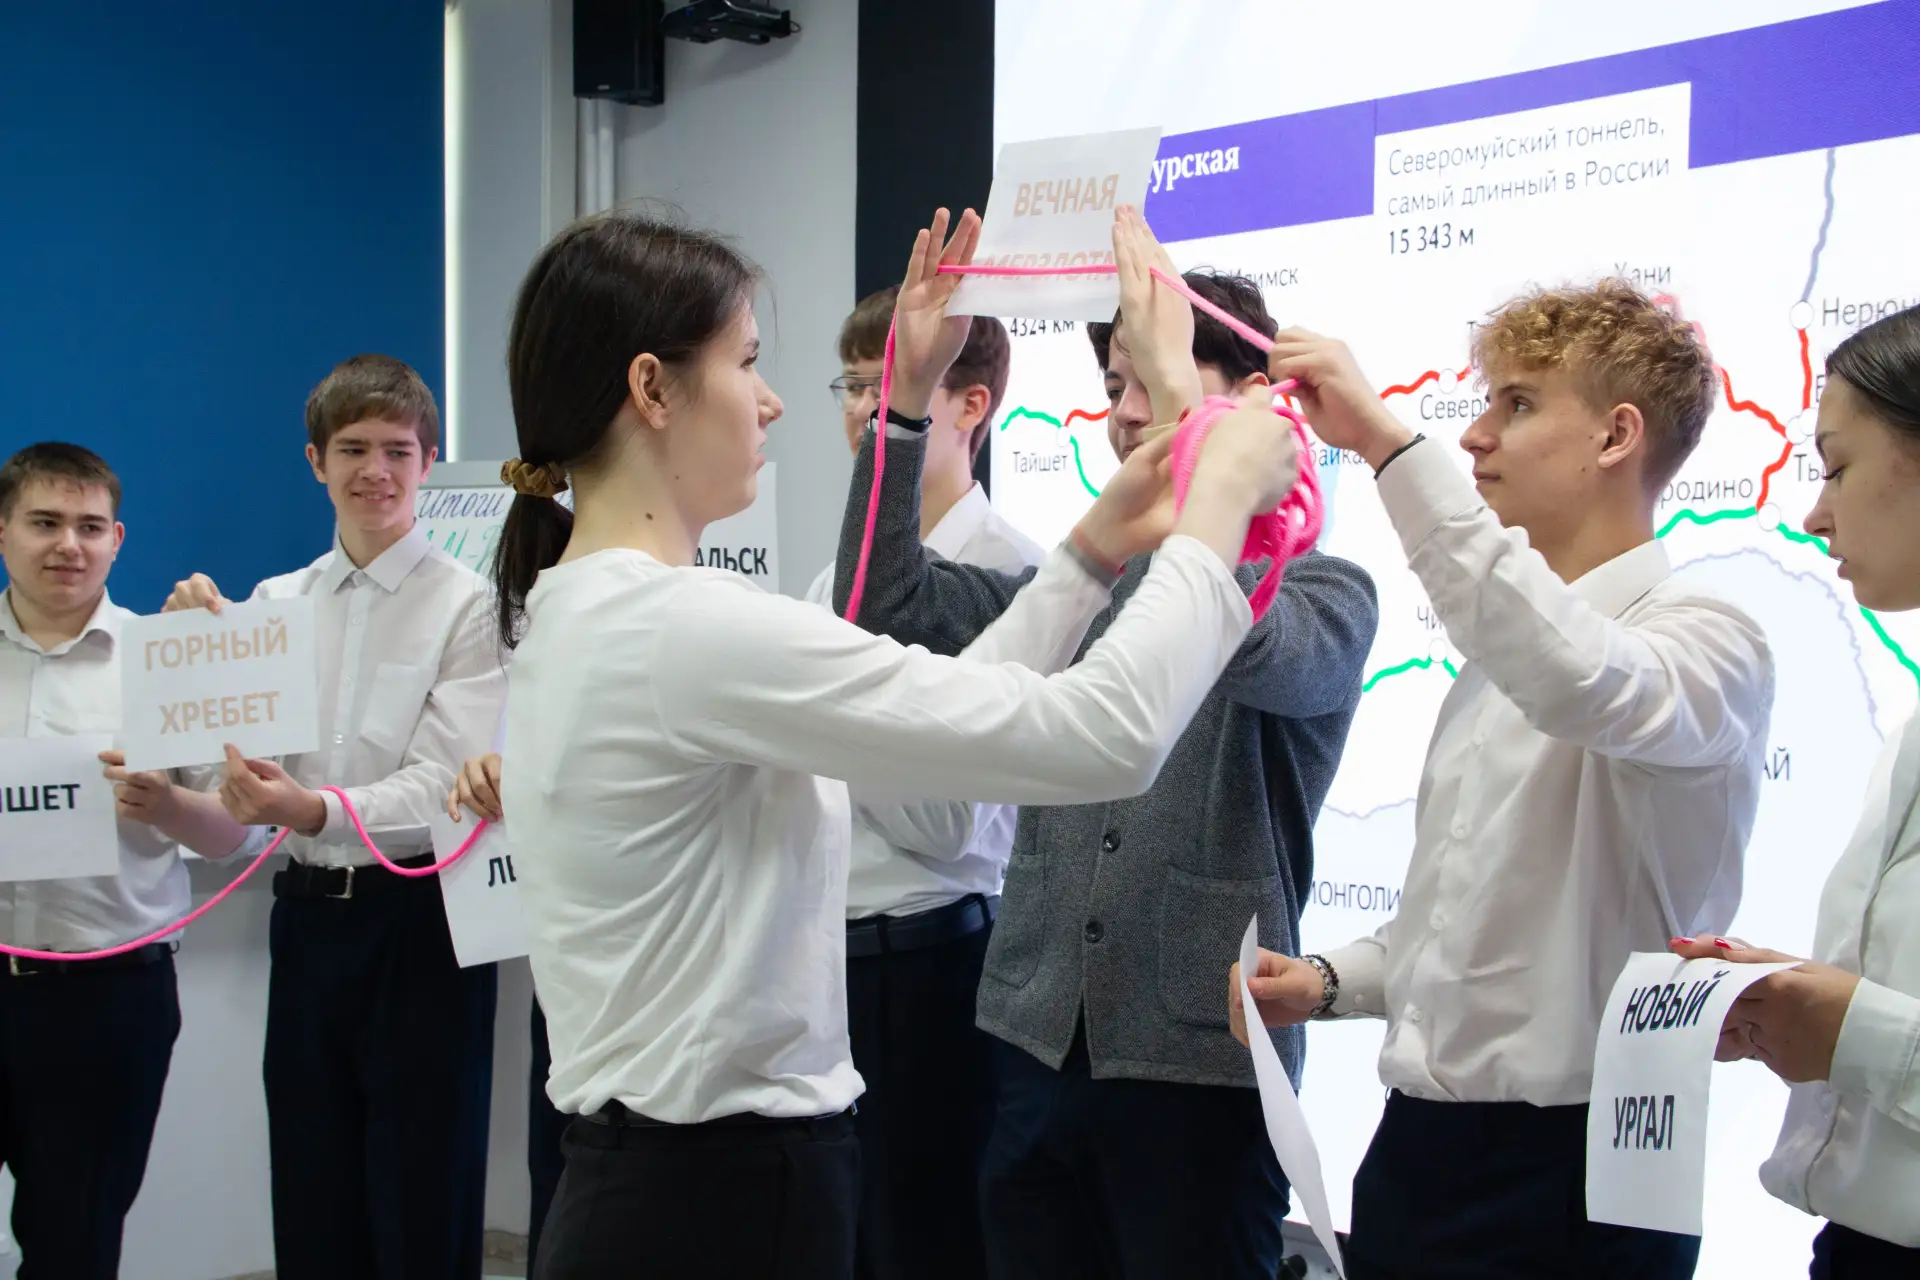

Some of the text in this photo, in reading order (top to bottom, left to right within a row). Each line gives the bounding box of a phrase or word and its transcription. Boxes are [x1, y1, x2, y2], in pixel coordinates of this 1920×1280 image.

[1149, 146, 1241, 194] урская
[1388, 115, 1666, 177] Северомуйский тоннель,
[1013, 174, 1119, 217] ВЕЧНАЯ
[1387, 157, 1671, 217] самый длинный в России
[1388, 222, 1475, 255] 15 343 м
[1013, 450, 1068, 474] Тайшет
[145, 615, 288, 672] ГОРНЫЙ
[158, 690, 280, 735] ХРЕБЕТ
[0, 783, 81, 813] ШЕТ
[1620, 969, 1730, 1035] НОВЫЙ
[1613, 1095, 1675, 1150] УРГАЛ
